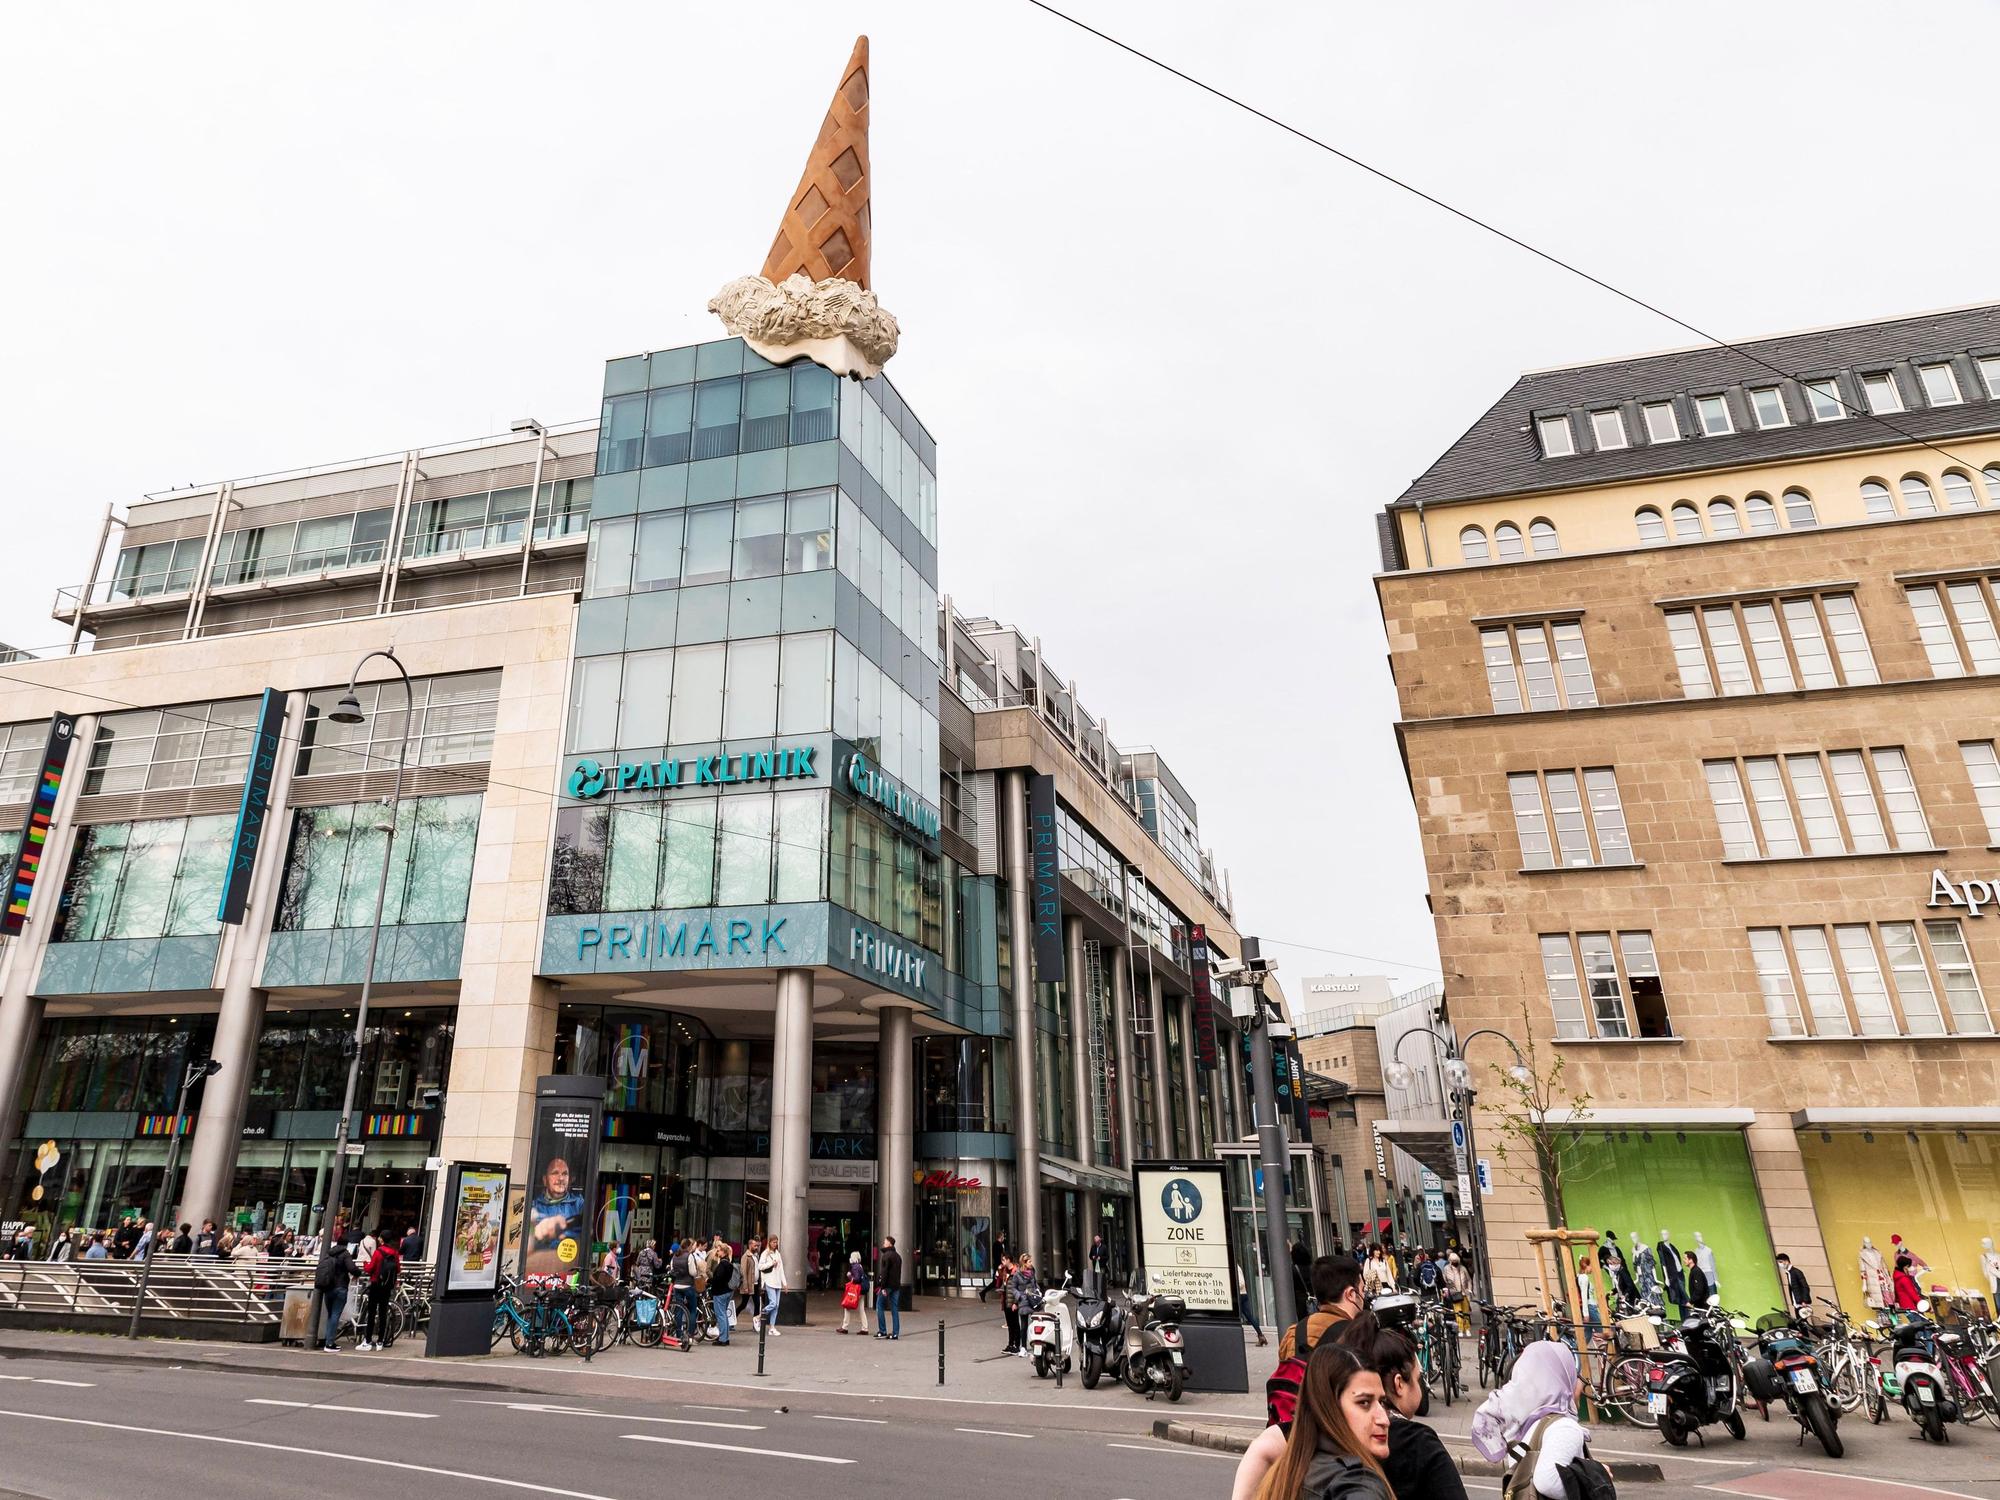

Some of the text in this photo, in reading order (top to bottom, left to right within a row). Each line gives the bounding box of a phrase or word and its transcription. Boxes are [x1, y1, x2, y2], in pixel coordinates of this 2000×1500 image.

[58, 723, 70, 736] M
[617, 746, 817, 791] PAN KLINIK
[236, 733, 277, 872] PRIMARK
[1035, 814, 1057, 936] PRIMARK
[578, 918, 787, 960] PRIMARK
[850, 927, 926, 991] PRIMARK
[1310, 983, 1360, 993] KARSTADT
[619, 1048, 648, 1077] M
[1290, 1056, 1302, 1098] SUBWAY
[242, 1127, 265, 1135] che.de
[657, 1132, 691, 1143] Mayersche.de
[756, 1135, 865, 1155] PARK
[1371, 1120, 1387, 1178] KARSTADT
[921, 1168, 982, 1189] Alice
[1427, 1199, 1443, 1207] PAN
[1, 1221, 26, 1230] HAPPY
[1167, 1227, 1205, 1241] ZONE
[1162, 1270, 1213, 1279] Lieferfahrzeuge
[1153, 1288, 1184, 1296] samstags
[1188, 1297, 1229, 1305] Entladen frei
